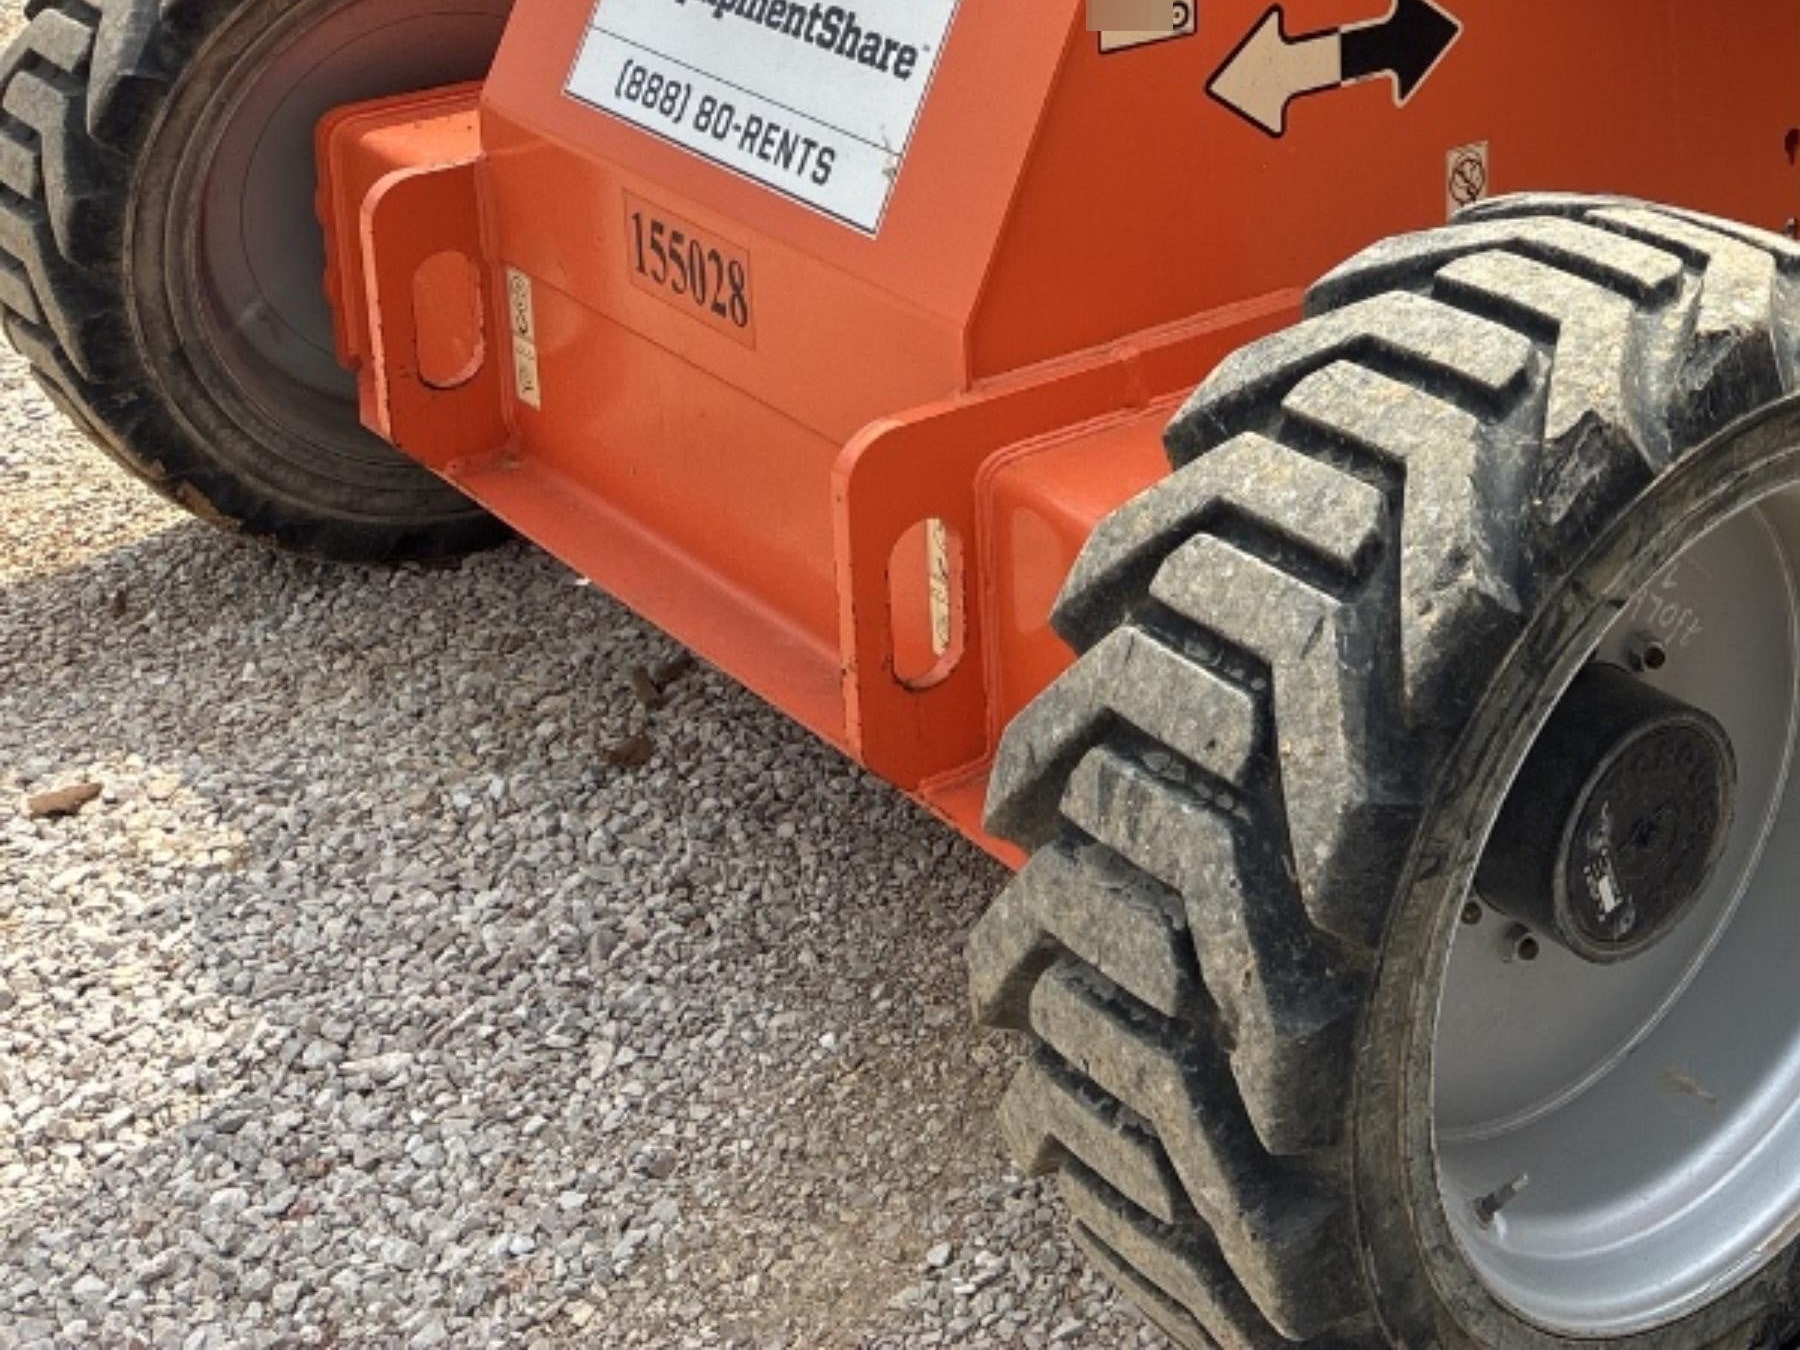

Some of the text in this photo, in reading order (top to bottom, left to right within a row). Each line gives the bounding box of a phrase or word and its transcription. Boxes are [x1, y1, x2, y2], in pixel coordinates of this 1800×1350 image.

[614, 58, 837, 187] (888) 80-RENTS
[630, 210, 750, 330] 155028
